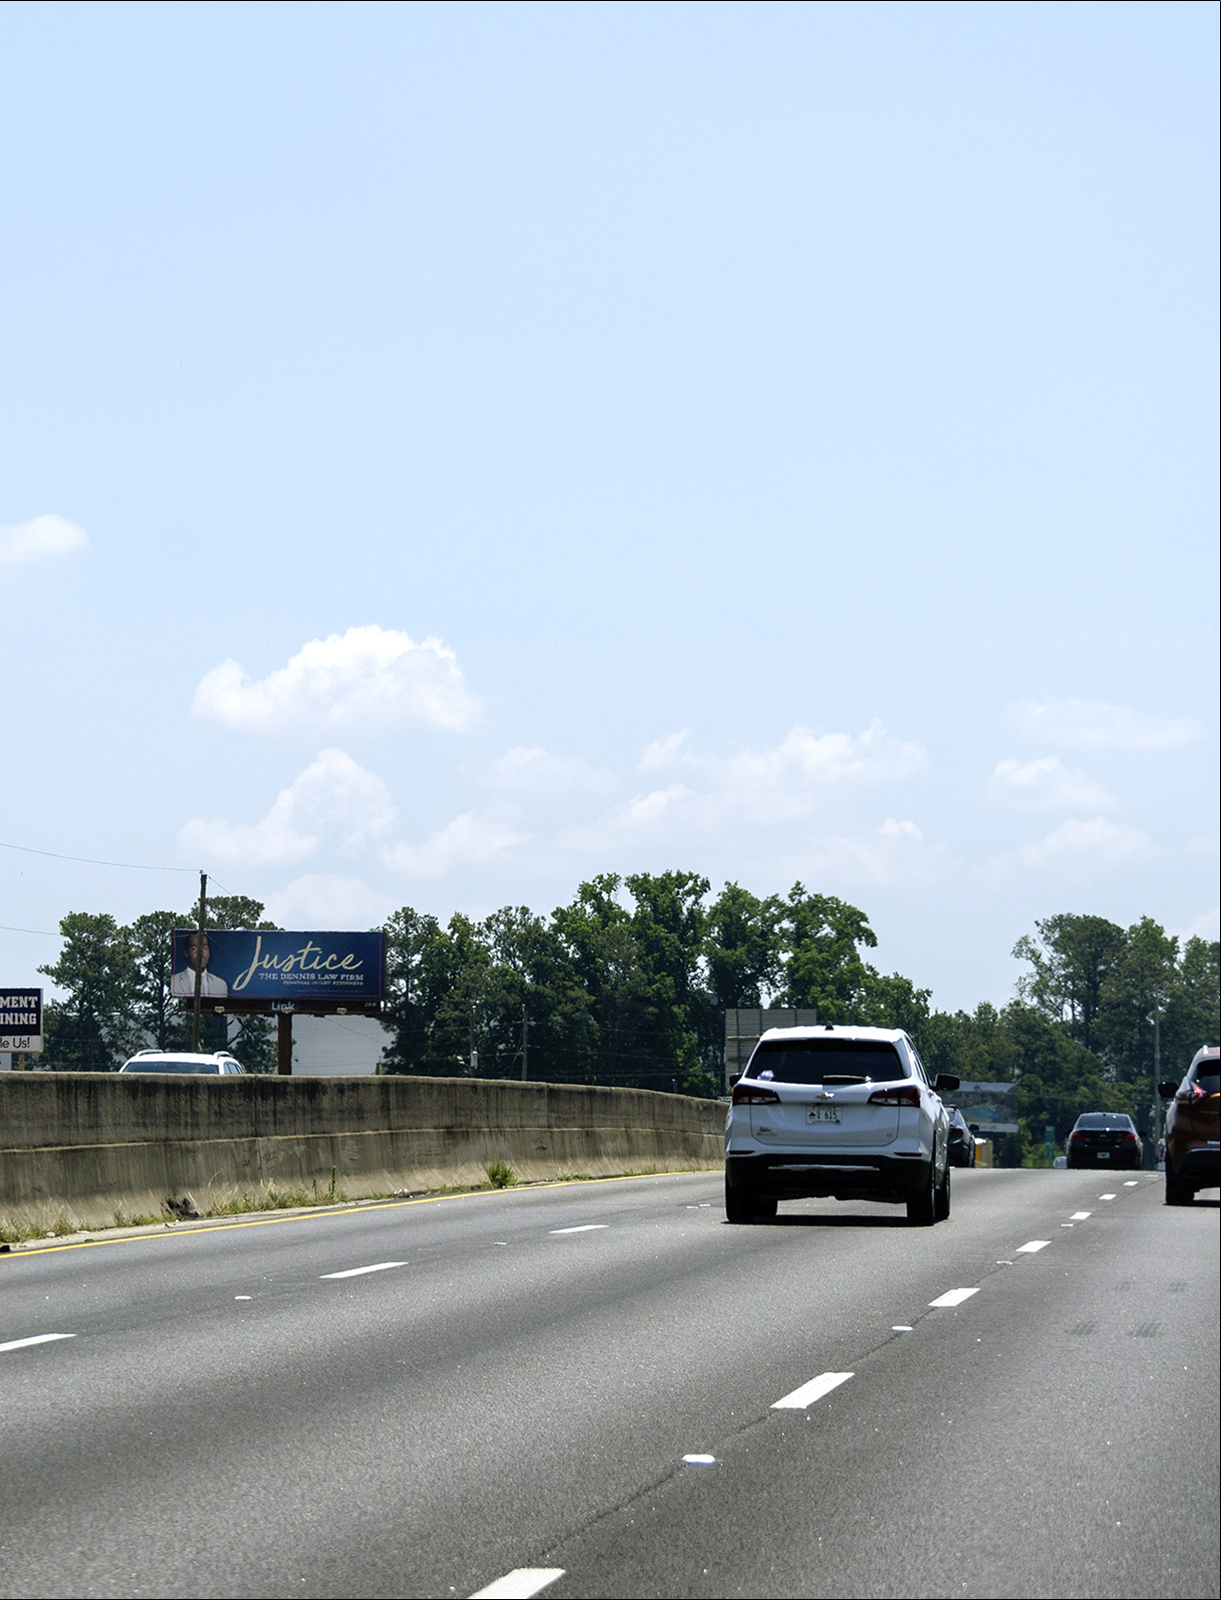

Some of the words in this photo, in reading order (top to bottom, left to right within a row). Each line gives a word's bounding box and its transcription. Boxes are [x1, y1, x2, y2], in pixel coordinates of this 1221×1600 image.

[232, 935, 364, 991] Justice
[258, 972, 279, 980] THE
[280, 972, 316, 980] DENNIS
[317, 973, 339, 981] LAW
[12, 1036, 31, 1049] Us!
